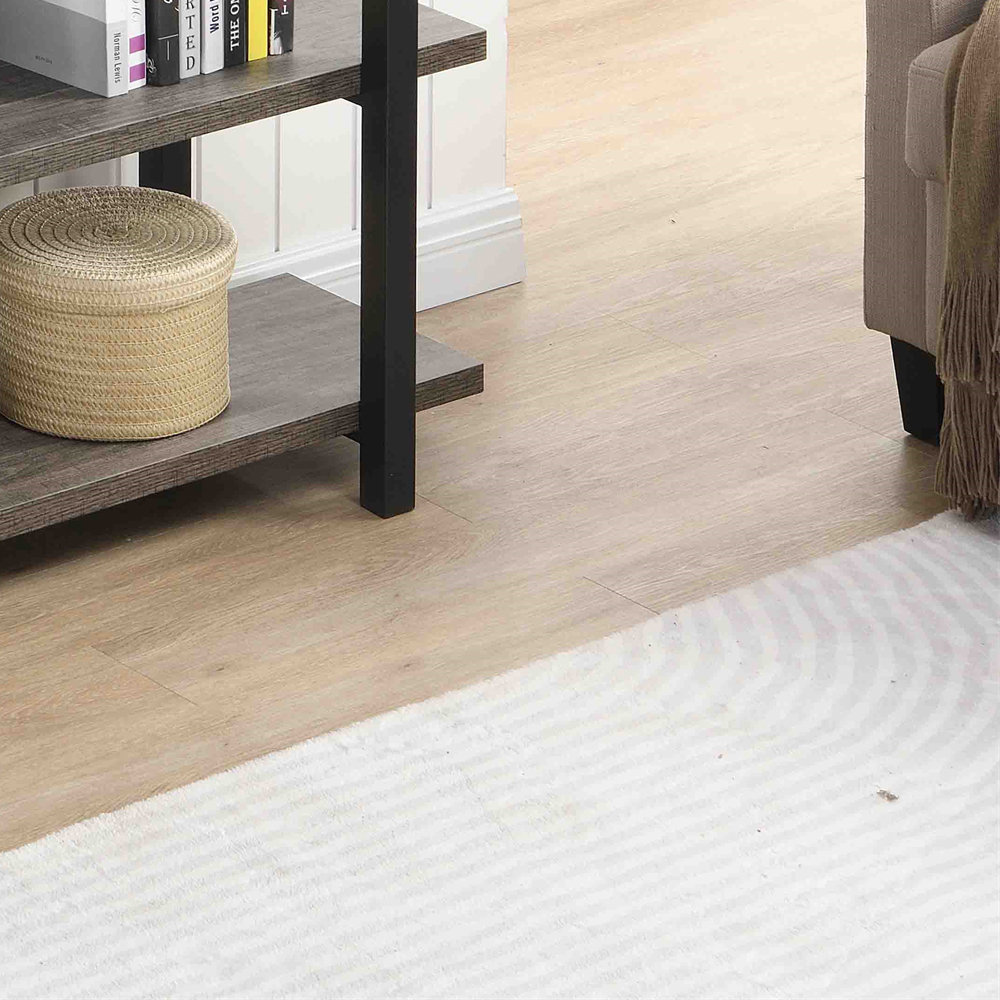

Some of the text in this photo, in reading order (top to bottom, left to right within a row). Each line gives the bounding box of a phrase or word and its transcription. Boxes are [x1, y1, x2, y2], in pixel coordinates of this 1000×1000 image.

[209, 4, 220, 33] Word
[230, 19, 240, 51] THE
[113, 32, 122, 84] Norman Lewis
